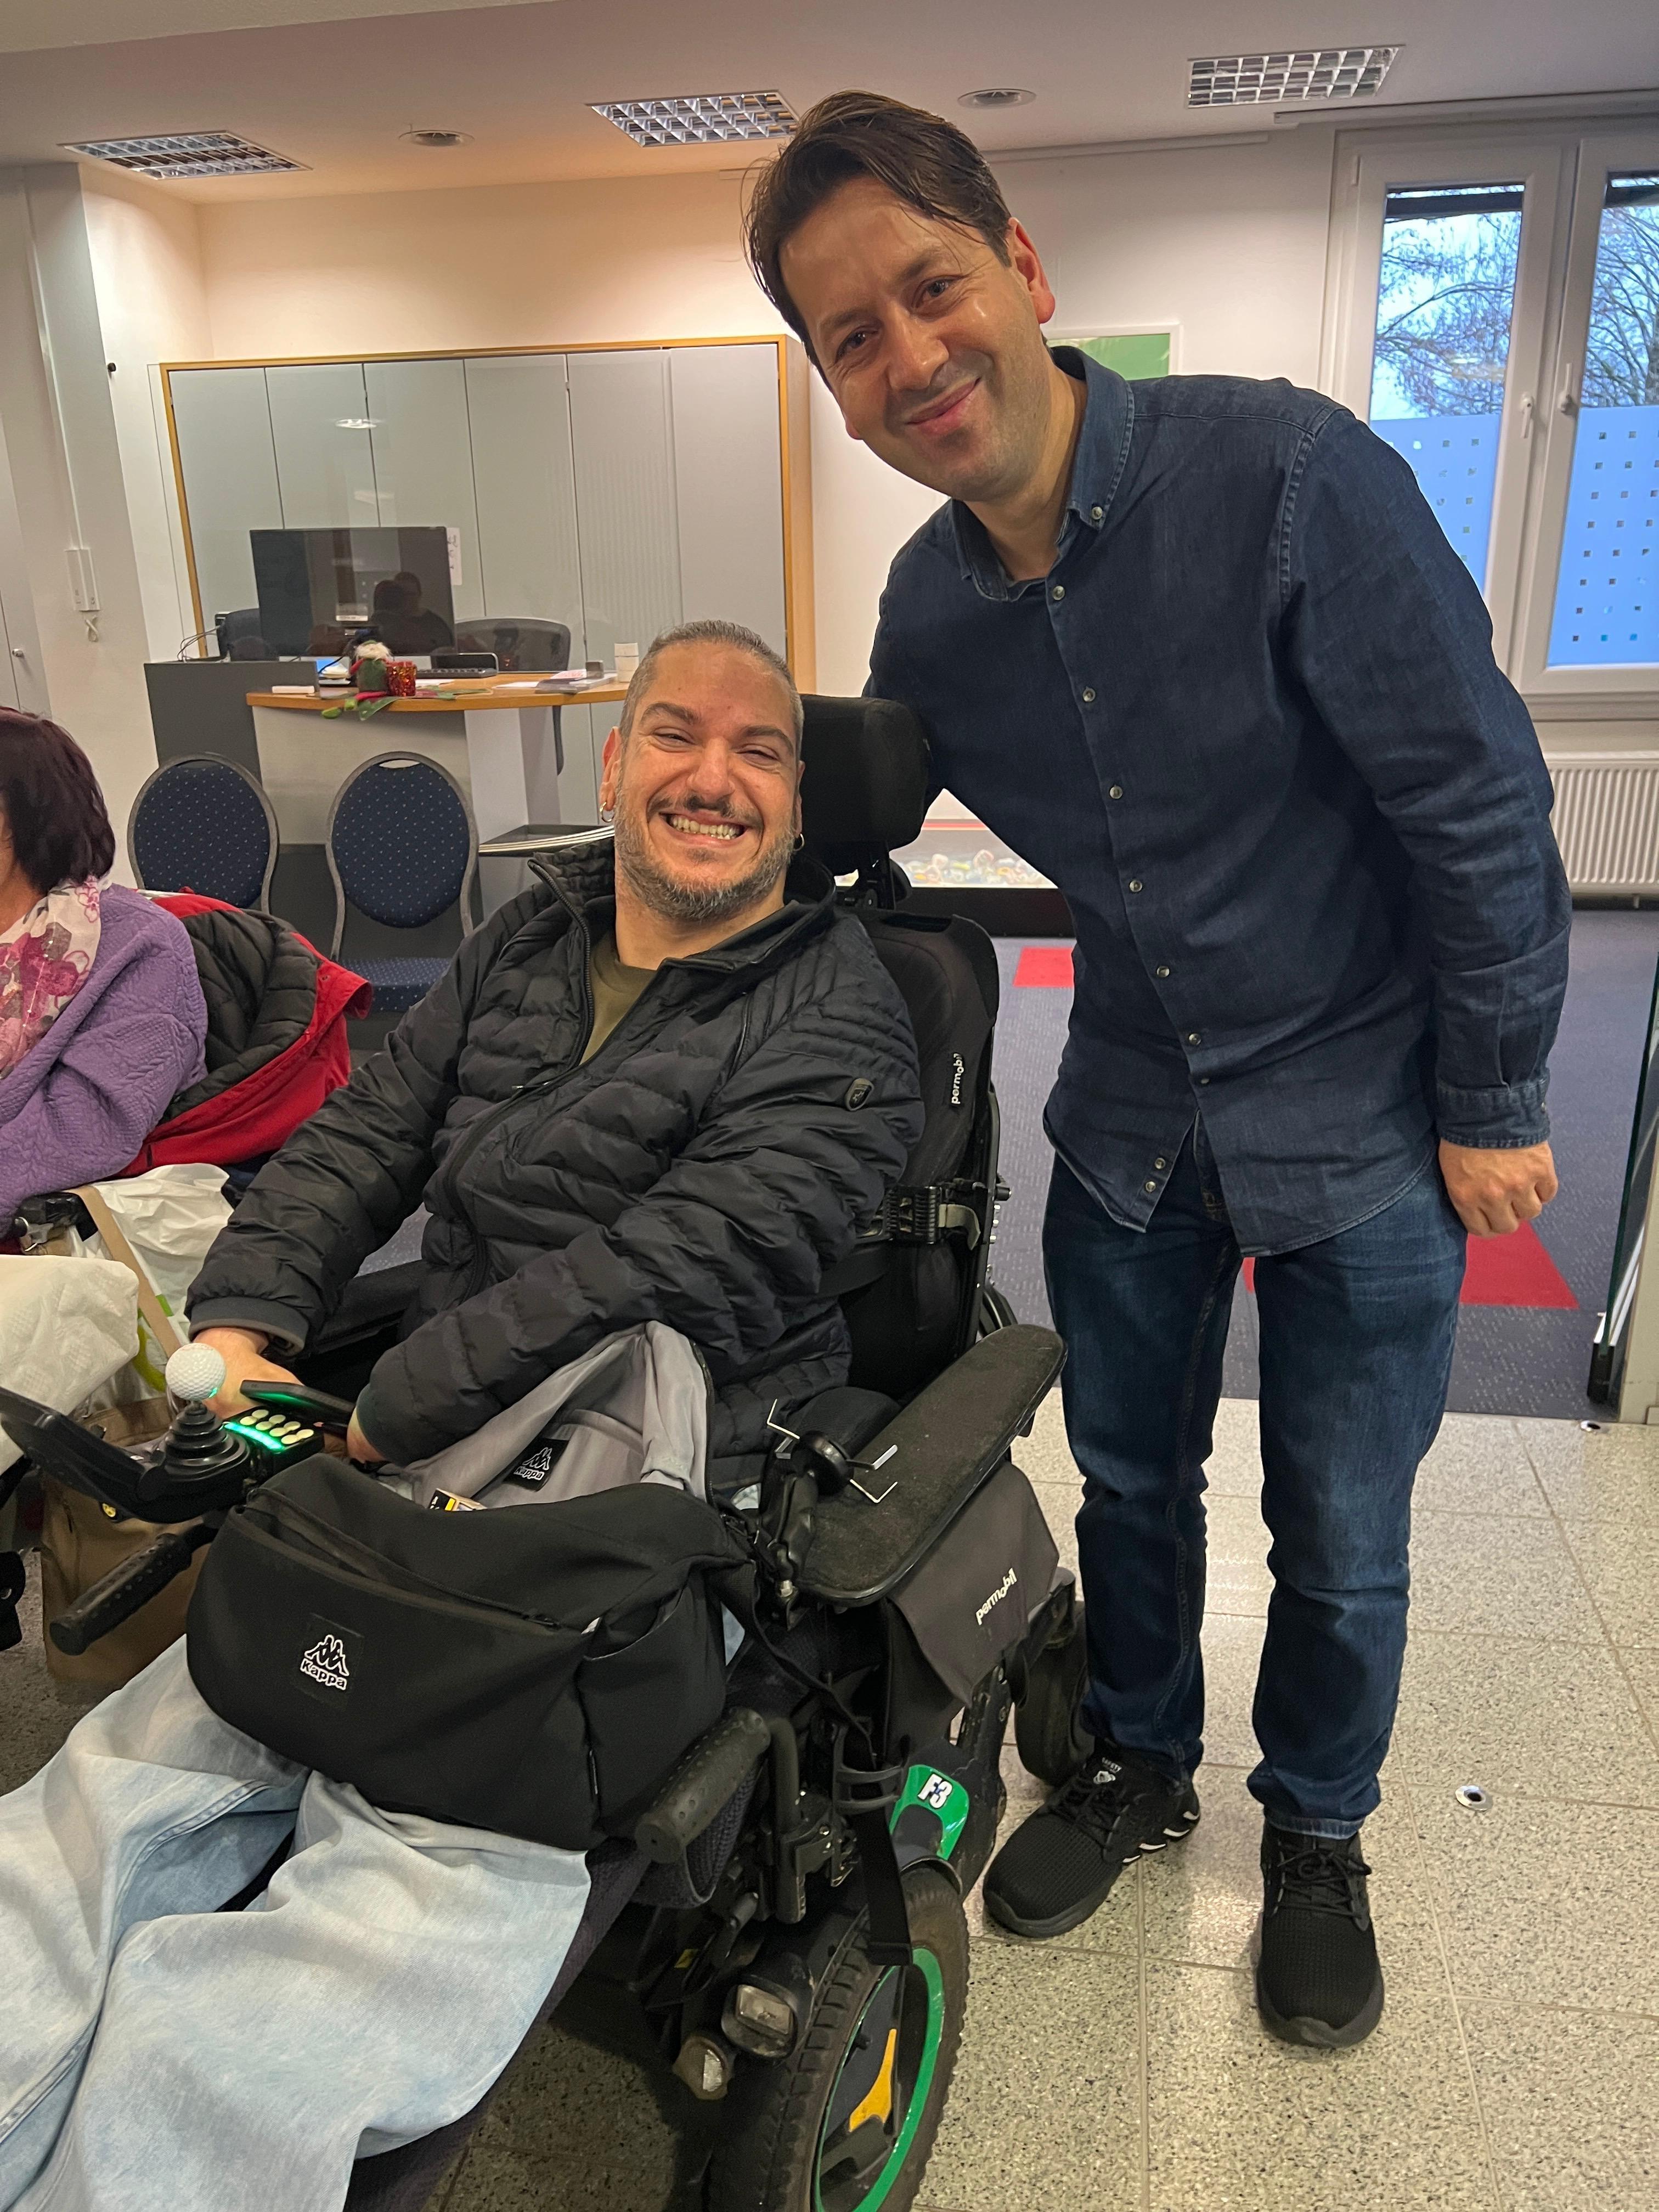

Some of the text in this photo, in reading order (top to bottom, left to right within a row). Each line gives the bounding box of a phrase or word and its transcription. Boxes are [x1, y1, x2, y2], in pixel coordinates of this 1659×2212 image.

[514, 1466, 545, 1480] Kappa
[975, 1567, 1017, 1626] permobil
[300, 1658, 347, 1690] Kappa
[917, 1773, 953, 1809] F3
